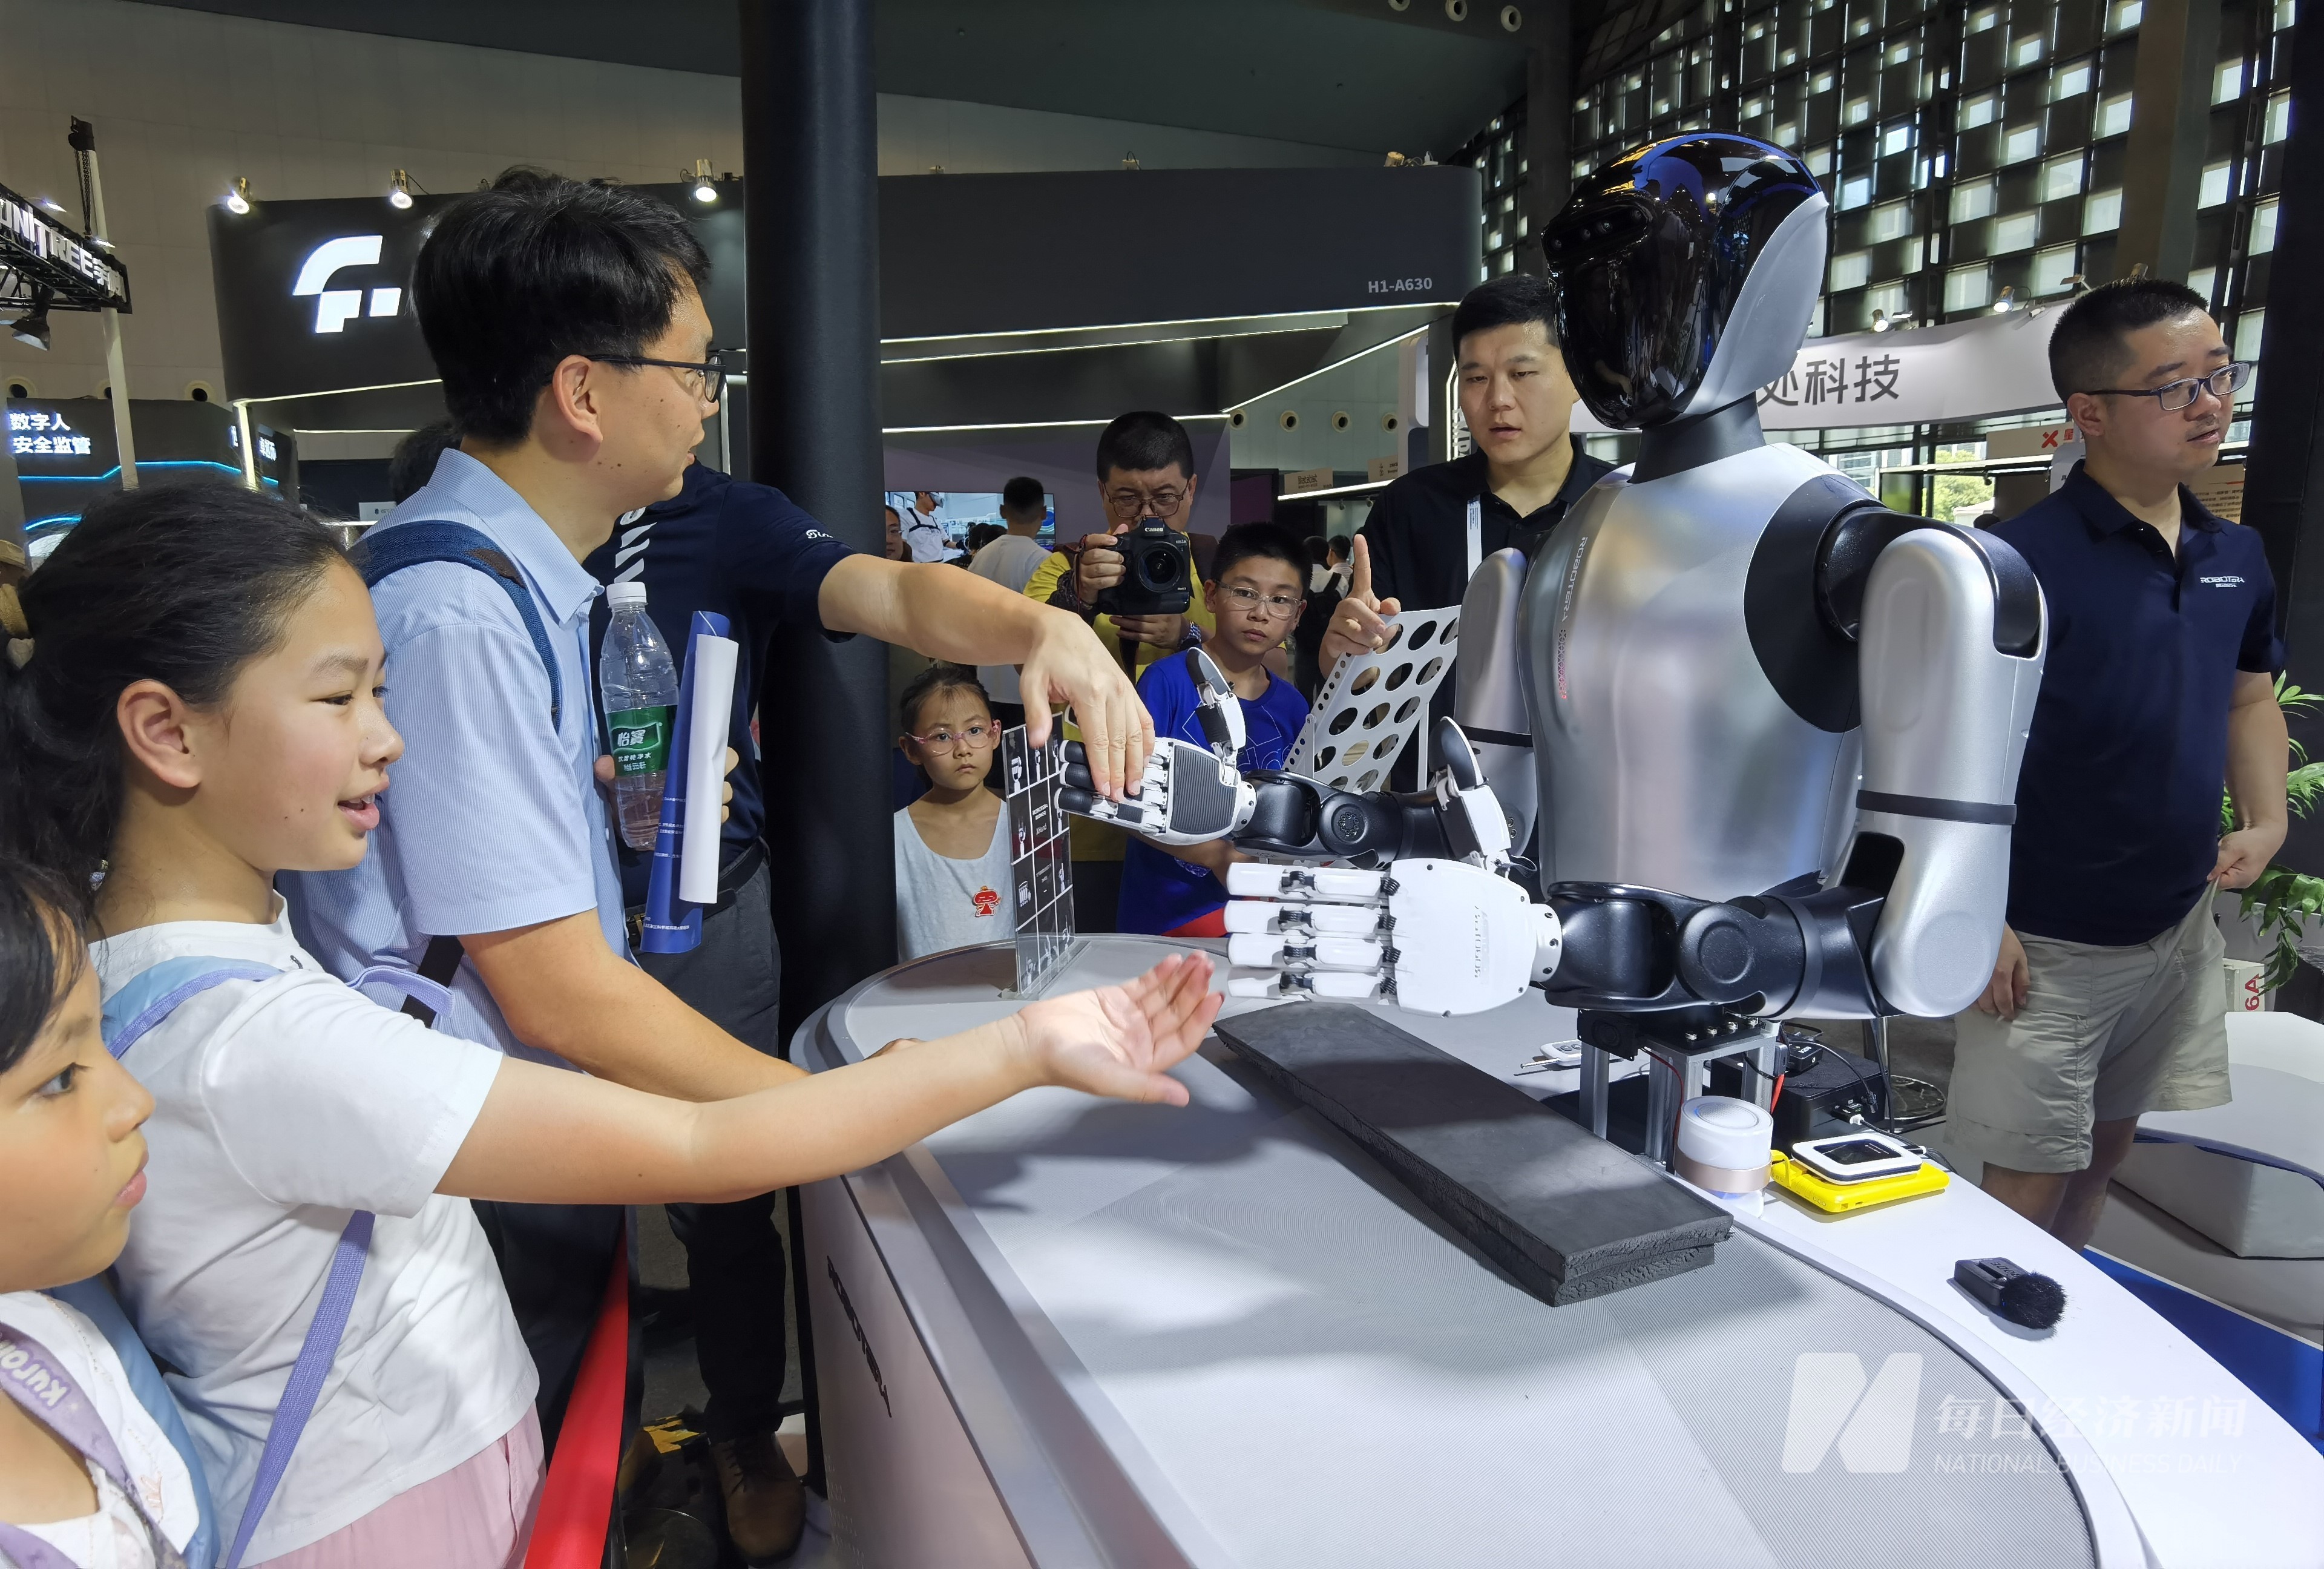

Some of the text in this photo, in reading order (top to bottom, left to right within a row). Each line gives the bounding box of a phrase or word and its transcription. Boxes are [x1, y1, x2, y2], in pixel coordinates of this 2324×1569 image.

[1368, 277, 1433, 293] H1-A630
[9, 413, 71, 430] 数字人
[13, 436, 91, 454] 安全监管
[1562, 536, 1588, 622] ROBOTERA
[617, 729, 646, 747] 怡寶
